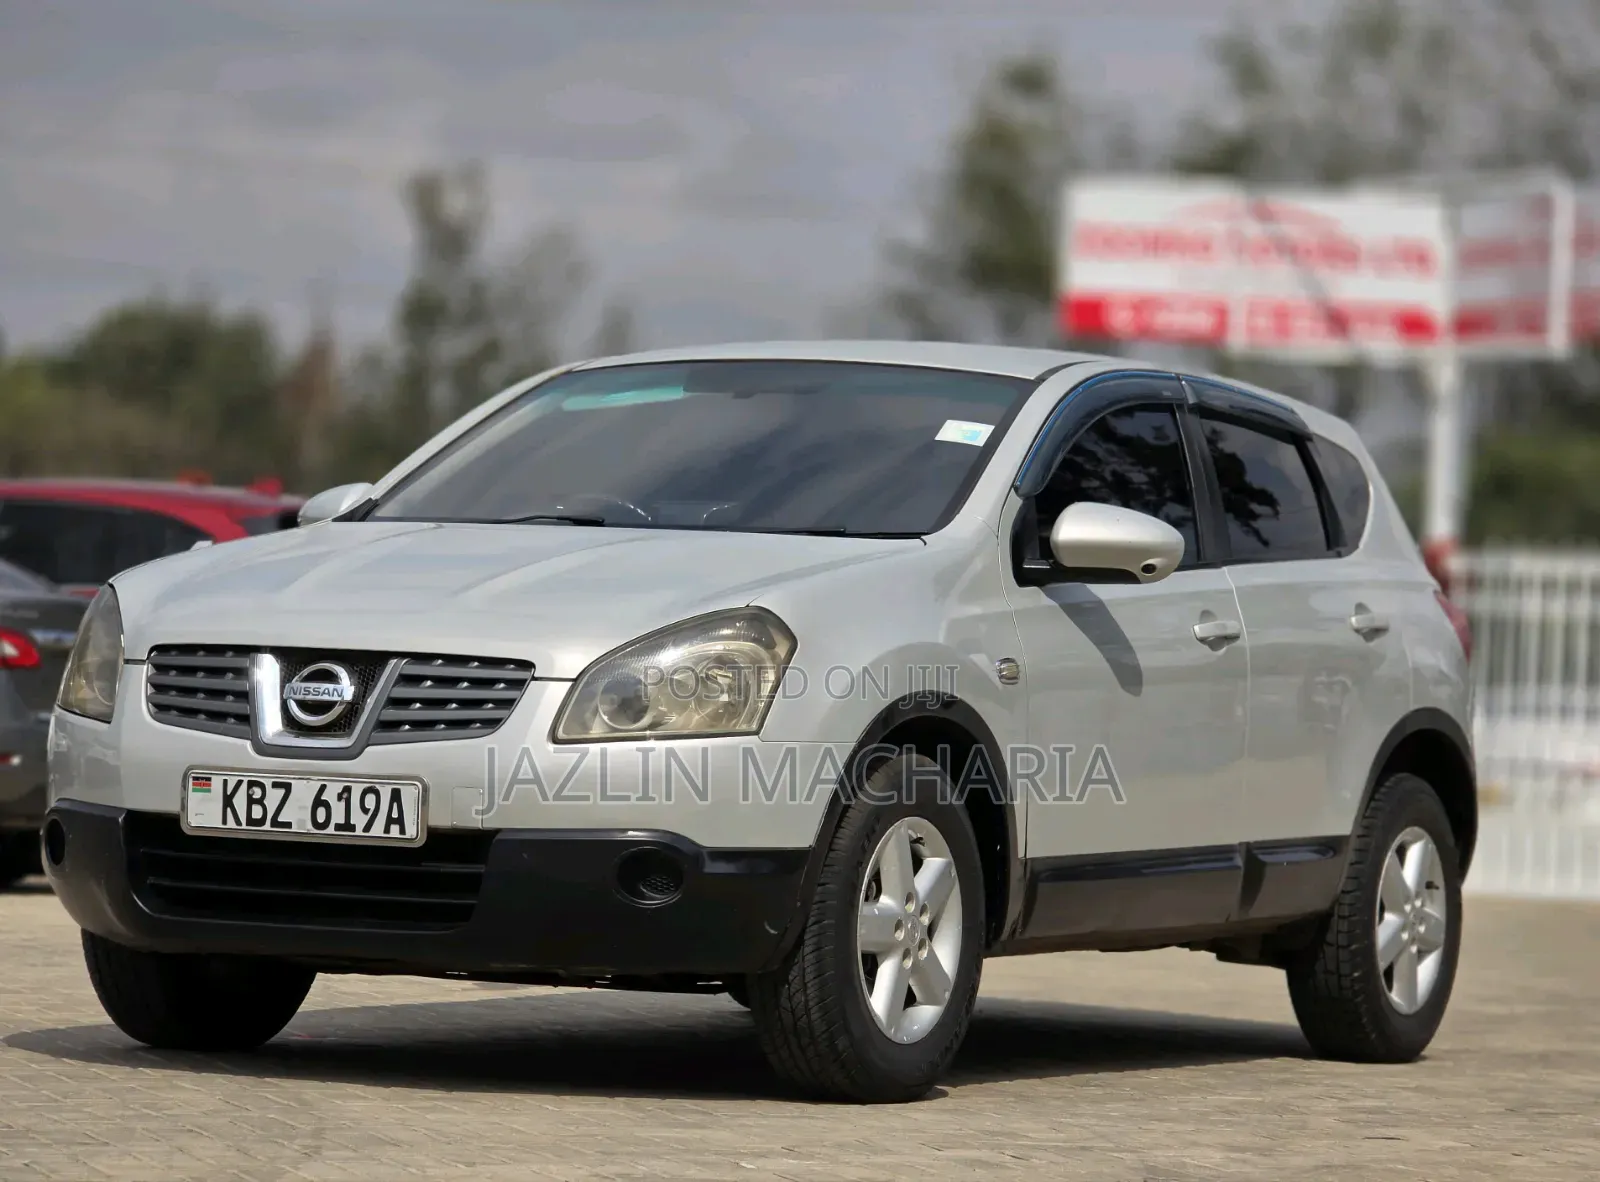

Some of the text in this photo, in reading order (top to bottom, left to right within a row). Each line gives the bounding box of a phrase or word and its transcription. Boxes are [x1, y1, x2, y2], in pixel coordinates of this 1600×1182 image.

[287, 685, 344, 699] NISSAN
[221, 778, 293, 829] KBZ
[309, 783, 407, 835] 619A
